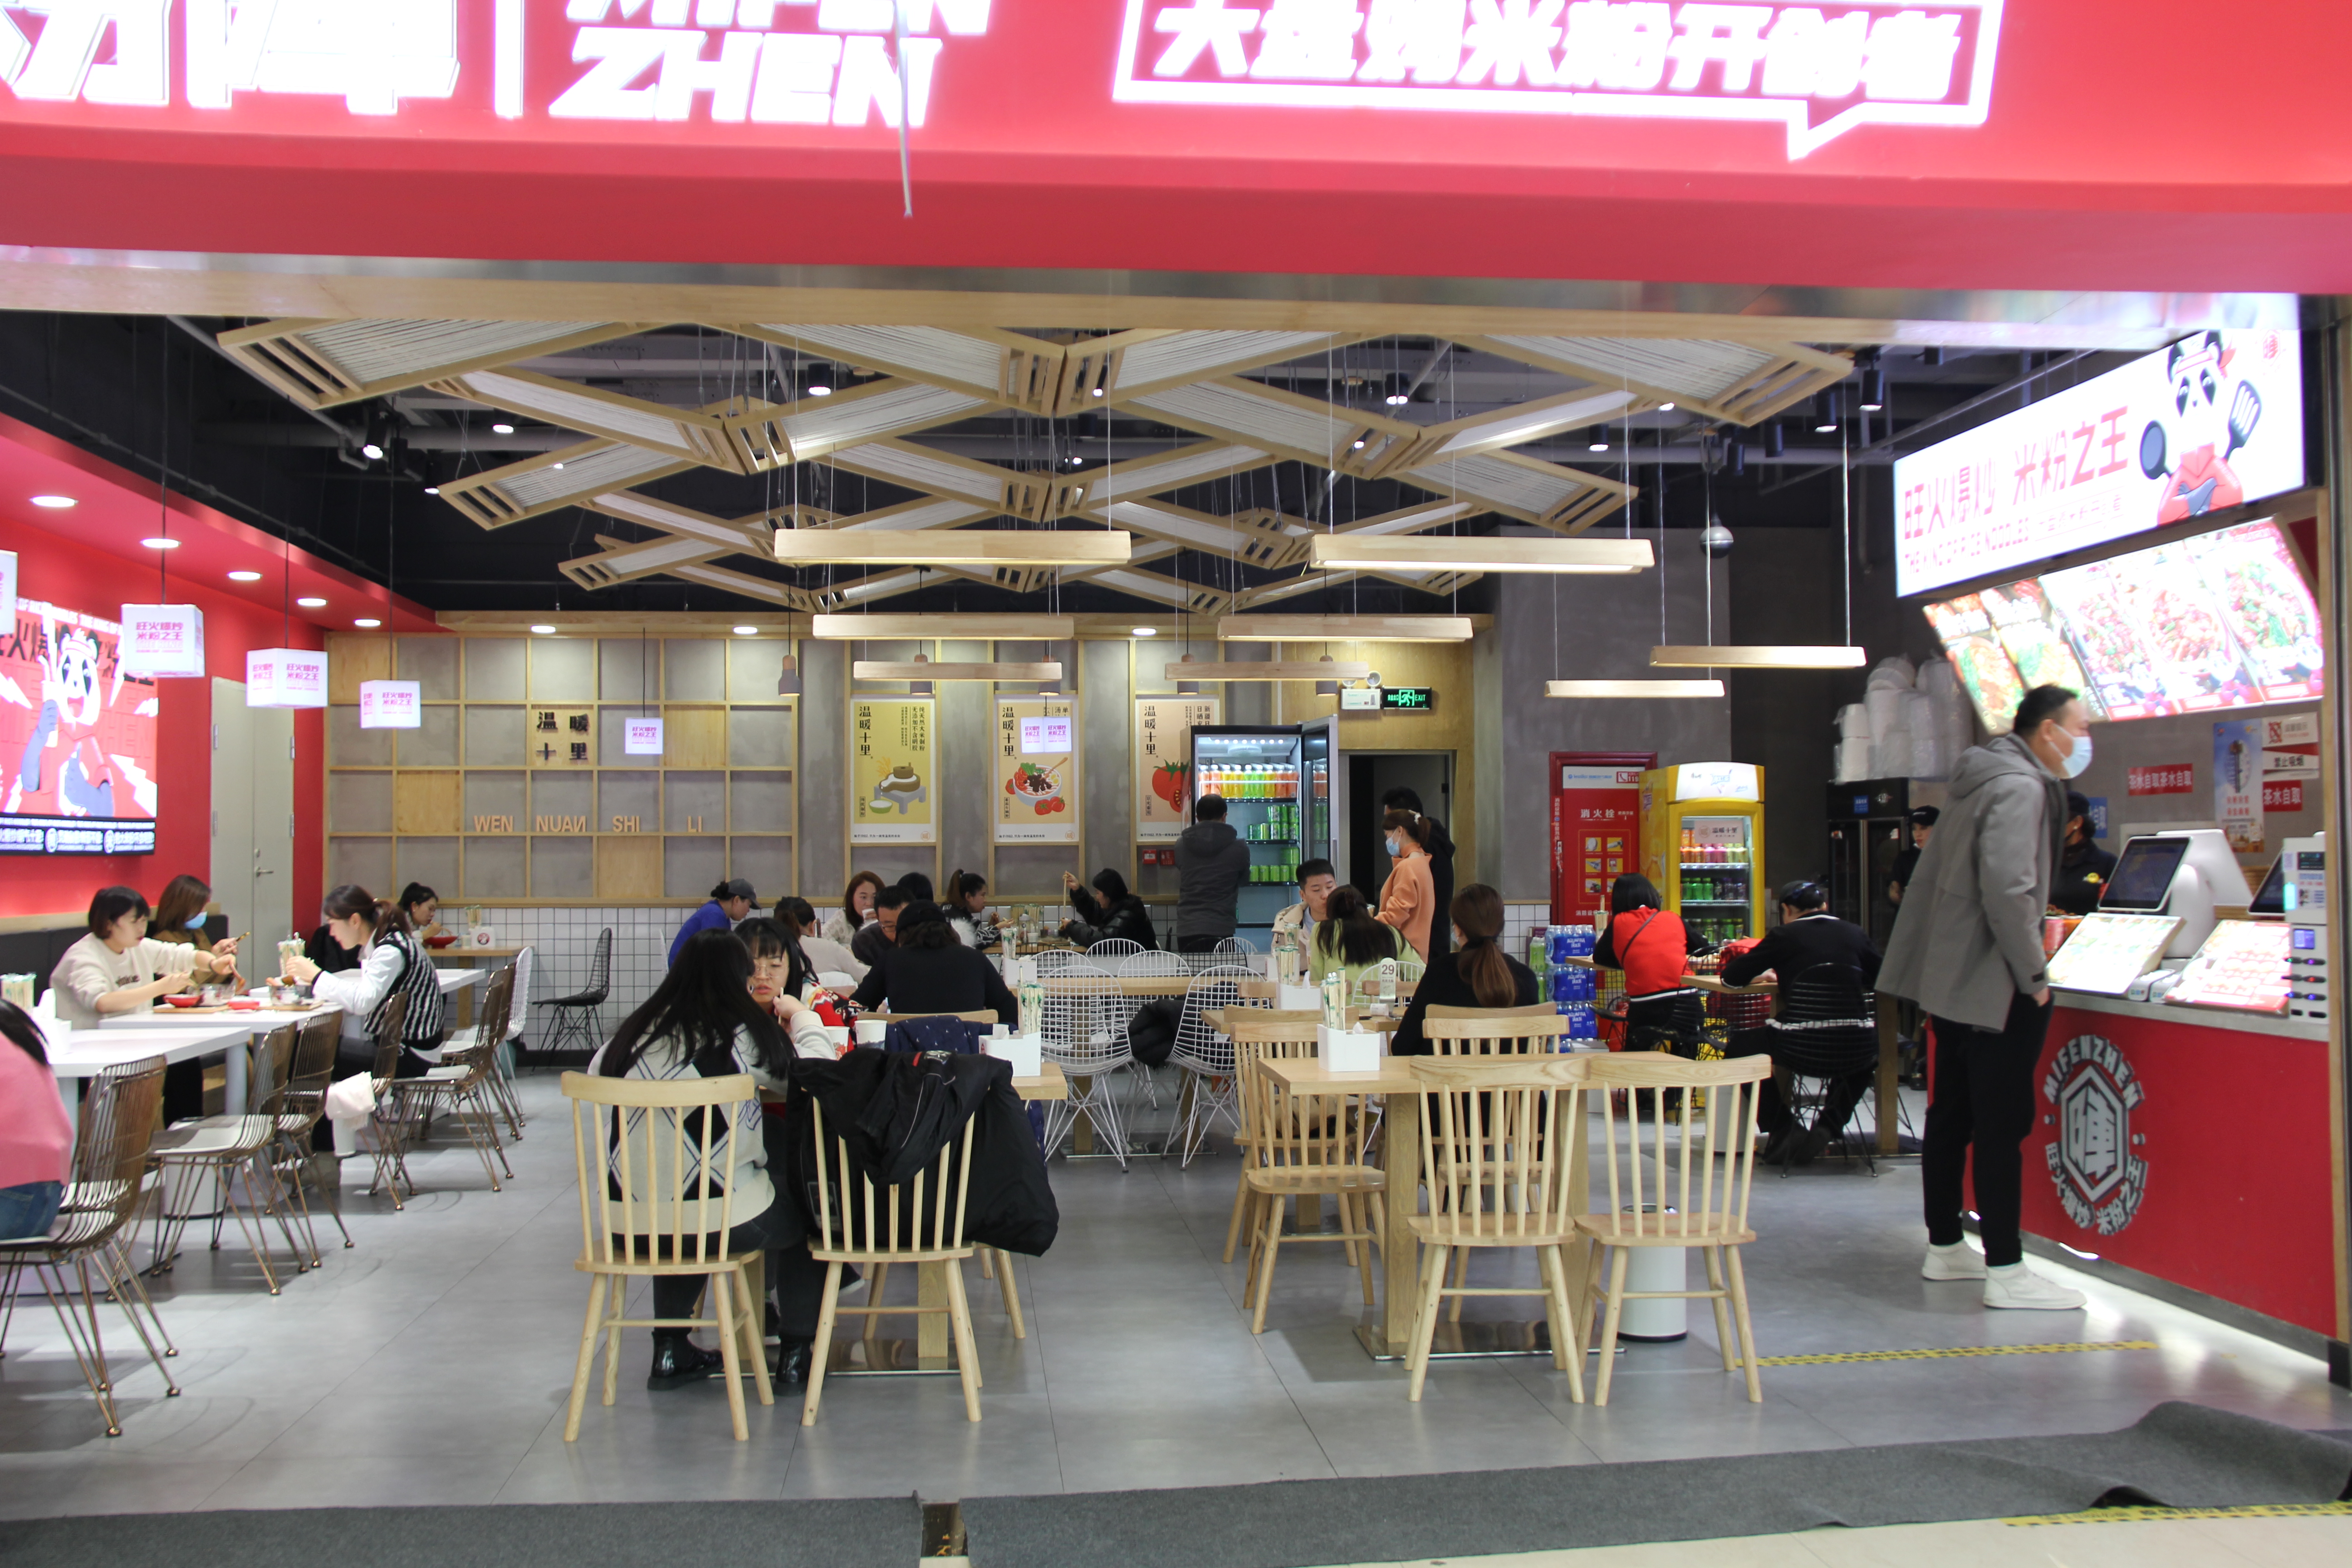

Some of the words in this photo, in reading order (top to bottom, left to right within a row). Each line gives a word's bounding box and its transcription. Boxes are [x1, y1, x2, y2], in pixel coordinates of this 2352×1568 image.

[548, 26, 944, 127] ZHEN
[1905, 457, 1996, 540] 旺火爆炒
[2012, 405, 2129, 506] 米粉之王
[1905, 551, 1920, 575] THE
[136, 631, 183, 640] 米粉之王
[537, 711, 589, 732] 温暖
[859, 706, 872, 756] 温暖十里
[1002, 706, 1015, 757] 温暖十里
[1144, 705, 1157, 755] 温暖十里
[536, 742, 589, 761] 十里
[2274, 755, 2304, 768] 禁止吸烟
[2263, 787, 2301, 805] 茶水自取
[1580, 808, 1615, 818] 消火栓
[473, 815, 514, 832] WEN
[536, 815, 587, 832] NUAN
[612, 815, 640, 832] SHI
[687, 815, 702, 832] LI
[1382, 964, 1395, 975] 29
